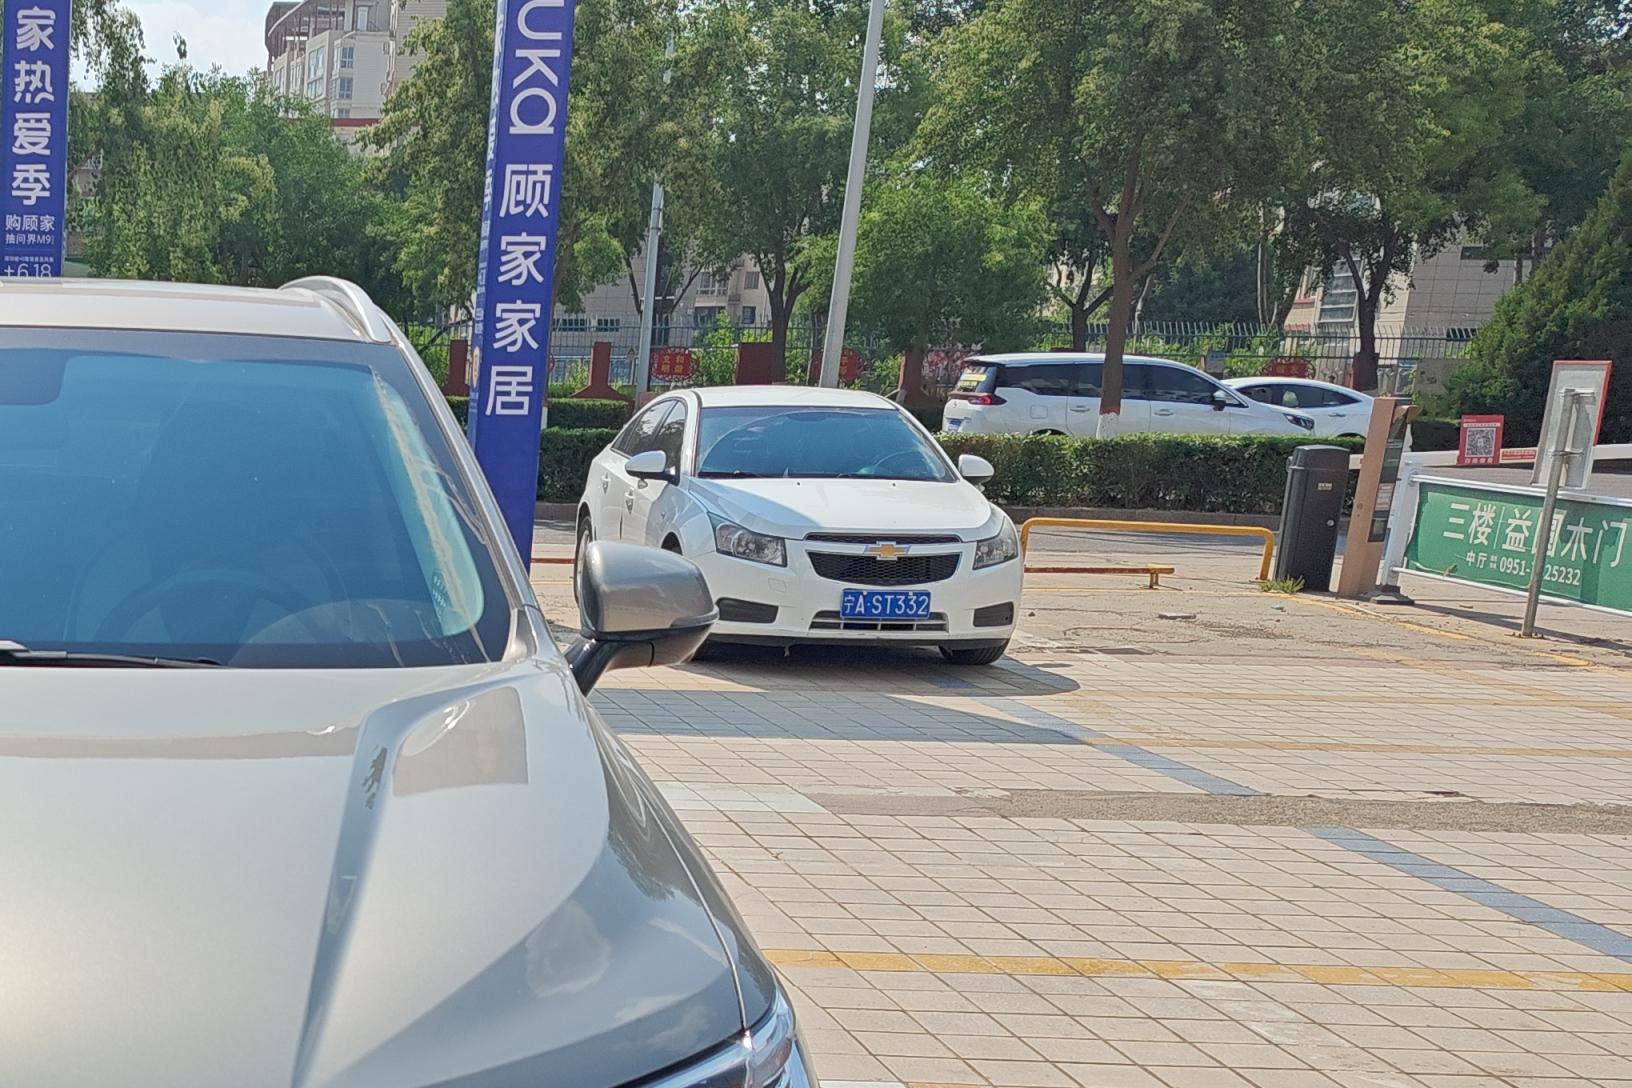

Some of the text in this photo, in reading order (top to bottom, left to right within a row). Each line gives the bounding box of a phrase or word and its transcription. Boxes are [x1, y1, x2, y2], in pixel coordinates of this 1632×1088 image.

[11, 6, 56, 206] 家热爱季
[5, 214, 55, 231] 购顾家
[485, 164, 554, 415] 顾家家居
[1443, 503, 1496, 545] 三楼
[1466, 550, 1488, 569] 中厅
[1499, 556, 1581, 586] 0951-25232
